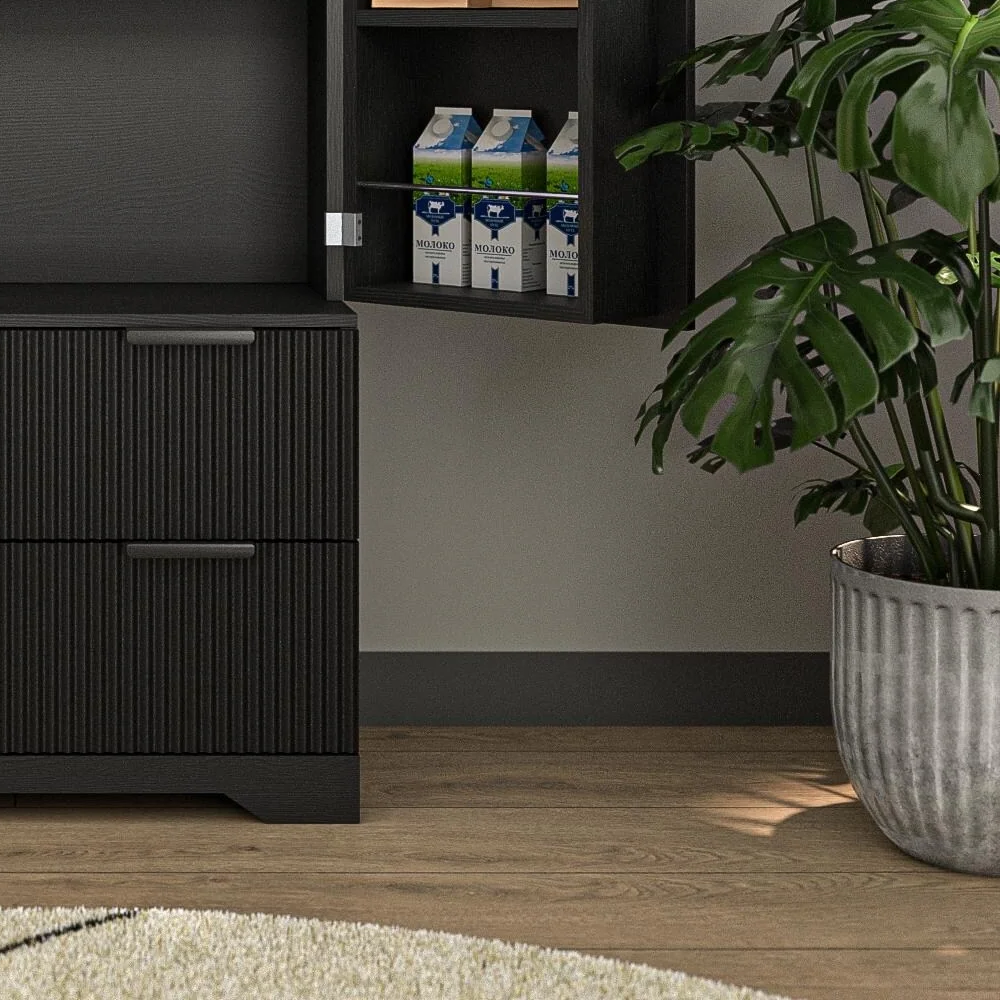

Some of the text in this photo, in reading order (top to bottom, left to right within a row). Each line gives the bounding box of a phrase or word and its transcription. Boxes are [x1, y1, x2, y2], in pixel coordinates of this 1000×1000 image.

[416, 239, 456, 250] МОЛОКО
[474, 243, 516, 255] МОЛОКО
[549, 249, 578, 260] МОЛО
